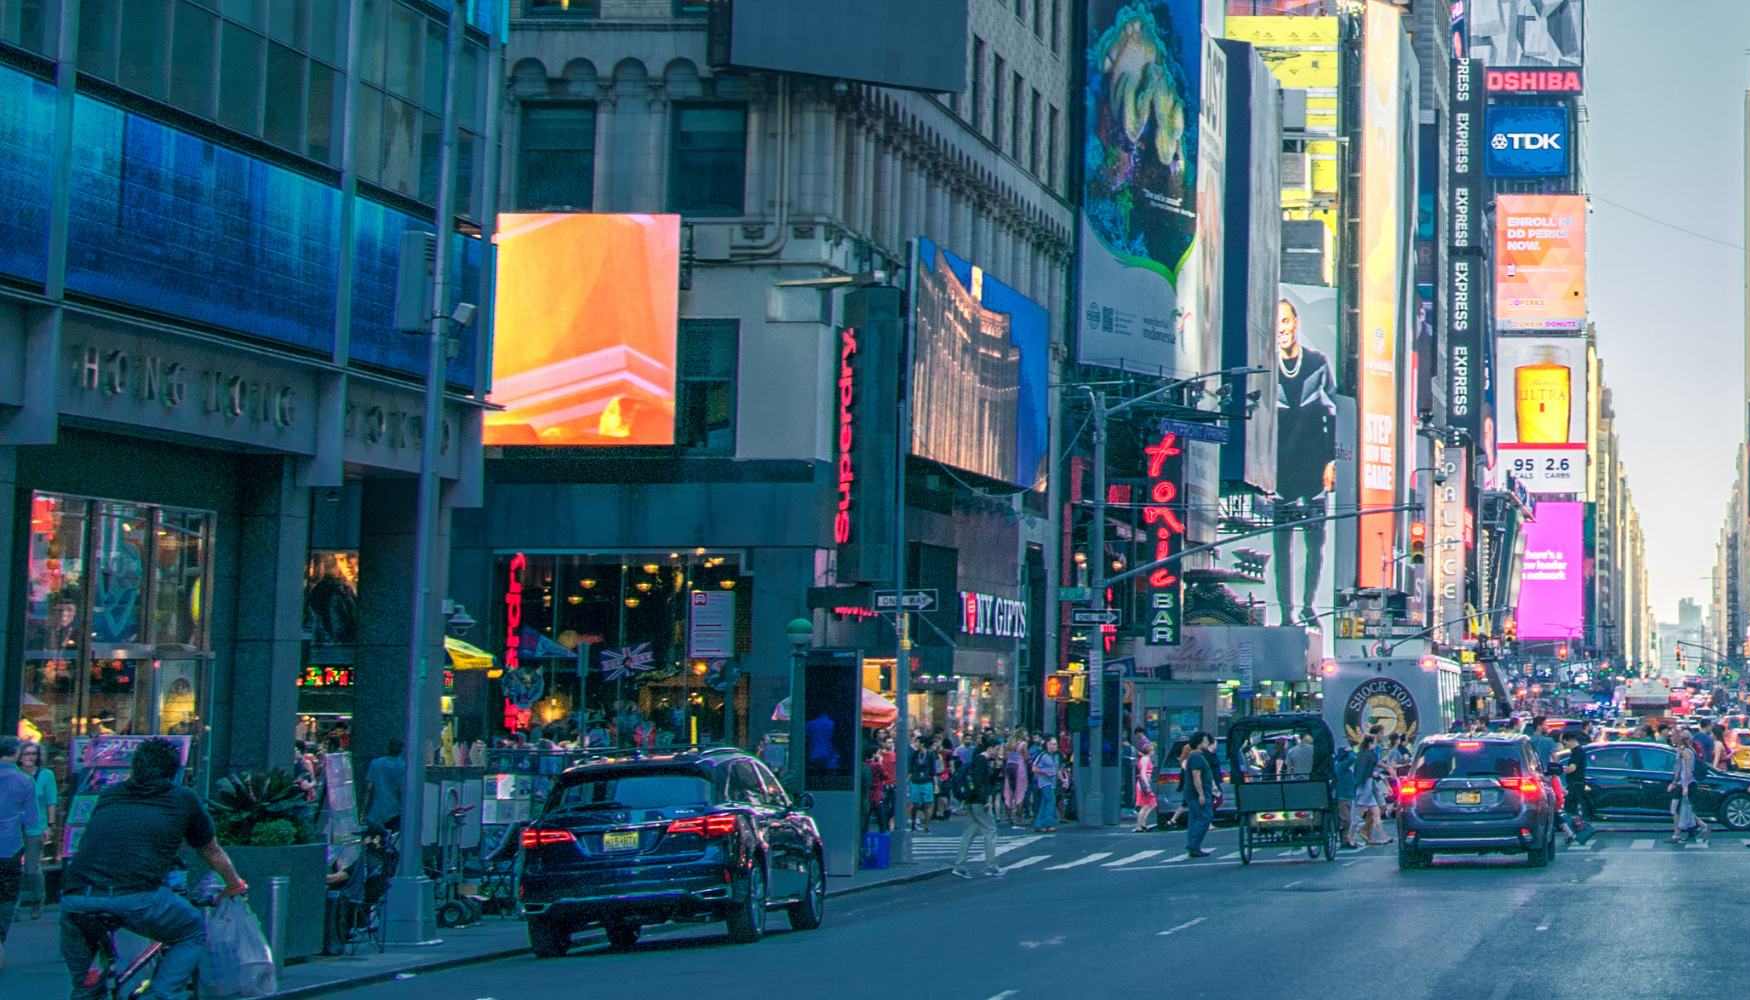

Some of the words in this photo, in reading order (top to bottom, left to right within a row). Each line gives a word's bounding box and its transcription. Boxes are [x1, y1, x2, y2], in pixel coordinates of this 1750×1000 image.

[1456, 58, 1470, 102] PRESS
[1486, 71, 1582, 92] OSHIBA
[1455, 112, 1470, 174] EXPRESS
[1506, 132, 1562, 150] TDK
[1454, 188, 1470, 248] EXPRESS
[1506, 216, 1556, 228] ENROLL
[1558, 217, 1573, 228] IN
[1506, 228, 1526, 240] DD
[1528, 228, 1568, 240] PERKS
[1506, 240, 1542, 252] NOW.
[1454, 262, 1468, 331] EXPRESS
[78, 346, 186, 407] HONG
[201, 370, 296, 428] KONG
[1453, 346, 1468, 416] EXPRESS
[1520, 388, 1566, 402] ULTRA
[1364, 412, 1392, 445] STEP
[1364, 463, 1392, 490] GAME
[1514, 458, 1534, 472] 95
[1545, 458, 1570, 472] 2.6
[1544, 472, 1571, 480] CARBS
[1442, 462, 1457, 600] PALACE
[1522, 562, 1536, 570] ew
[1536, 561, 1568, 570] leader
[1525, 549, 1555, 560] here's
[1556, 552, 1564, 560] a
[1527, 571, 1566, 580] network
[908, 595, 928, 605] WAY
[975, 592, 994, 636] NY
[995, 597, 1028, 639] GIFTS
[1152, 592, 1174, 644] BAR
[1350, 680, 1389, 712] SHOCK
[1390, 682, 1413, 710] TOP
